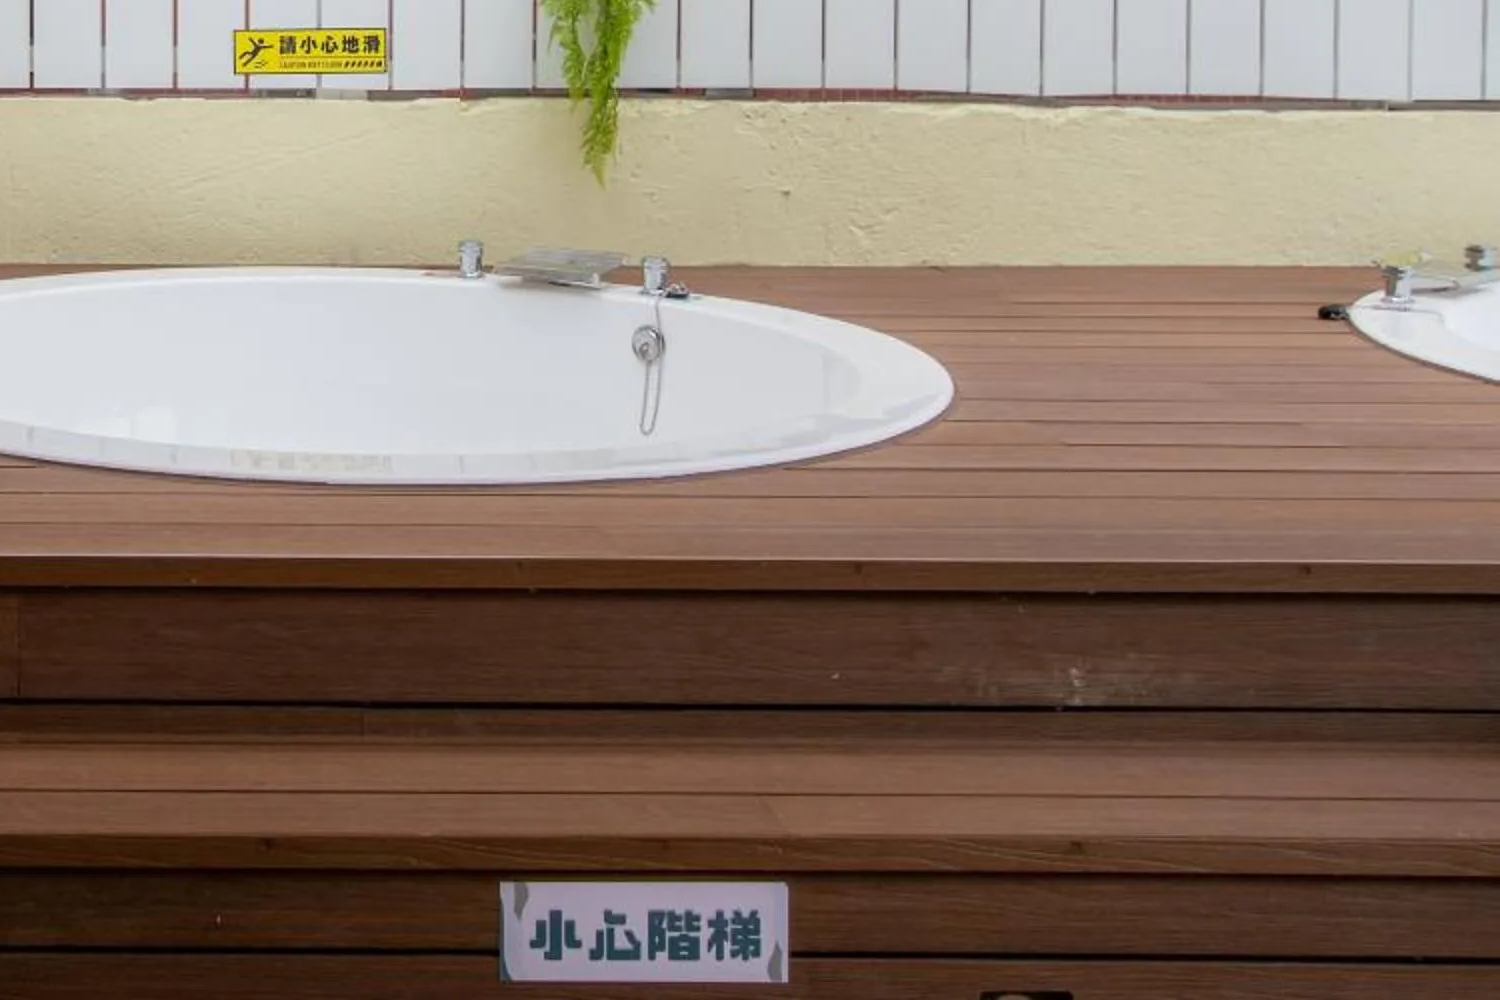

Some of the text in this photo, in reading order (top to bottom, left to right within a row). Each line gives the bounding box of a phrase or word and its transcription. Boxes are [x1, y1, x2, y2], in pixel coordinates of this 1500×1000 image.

[279, 35, 381, 55] 請小心地滑
[529, 908, 762, 962] 小心階梯
